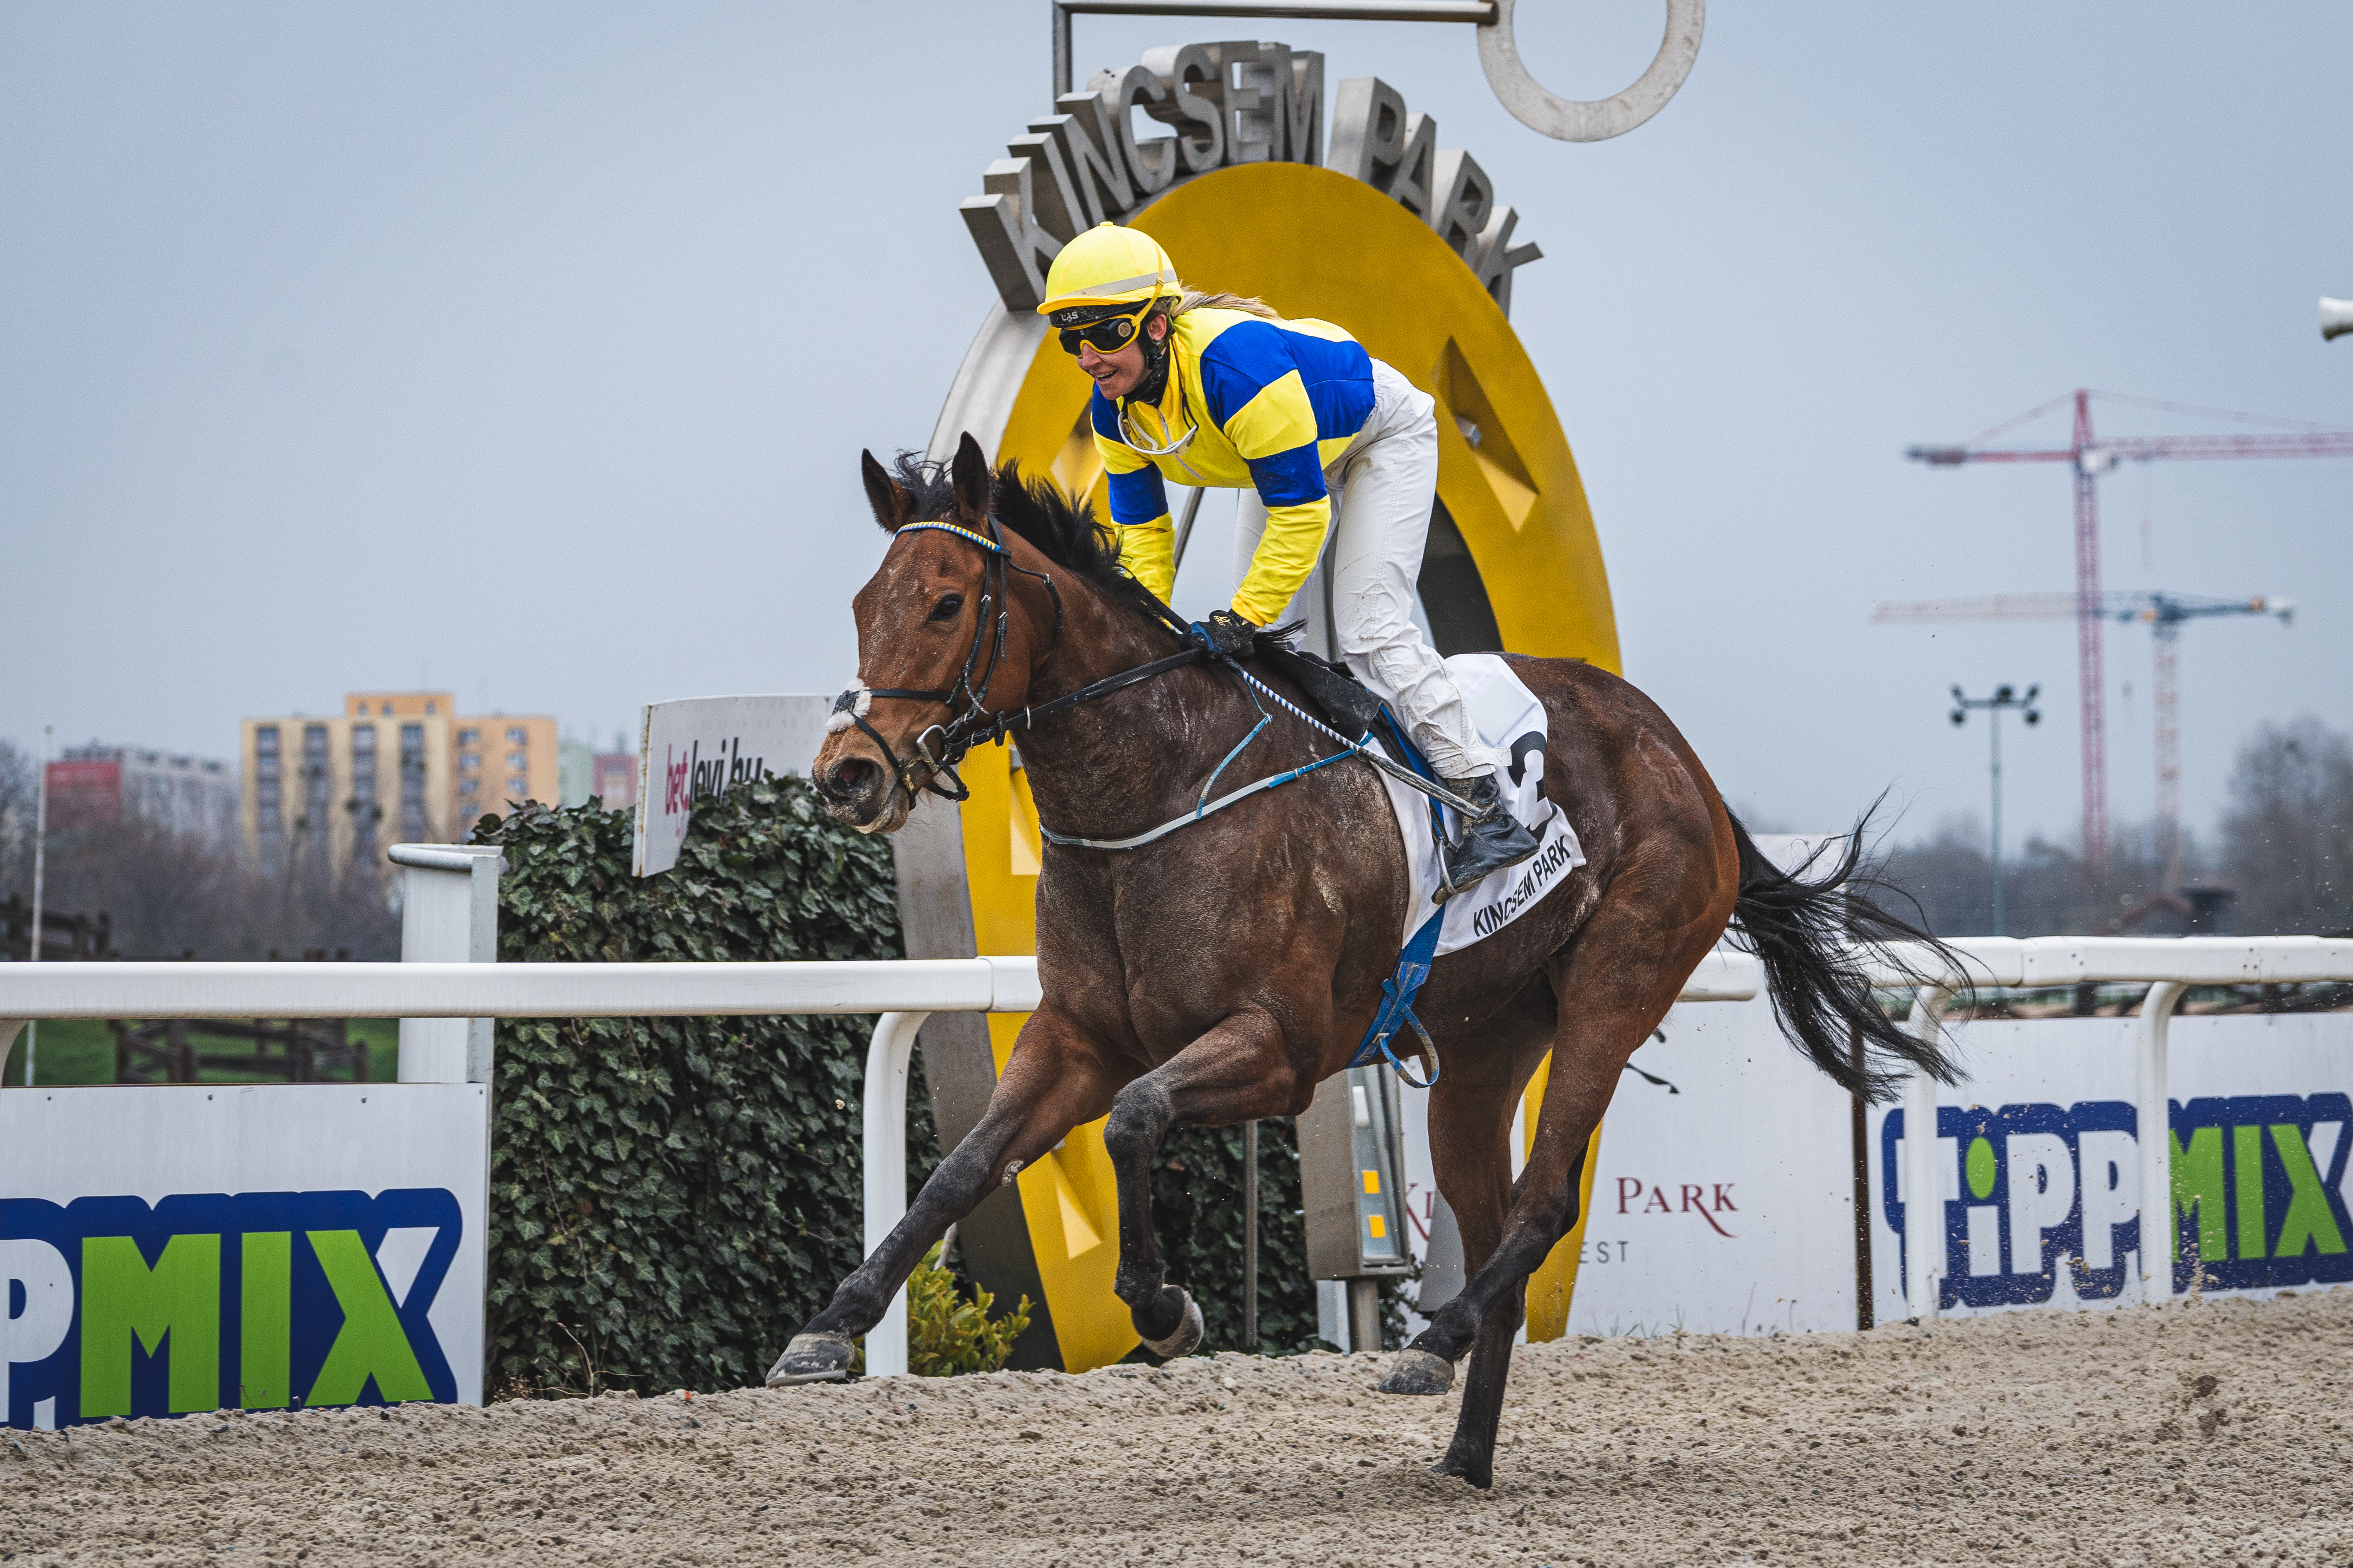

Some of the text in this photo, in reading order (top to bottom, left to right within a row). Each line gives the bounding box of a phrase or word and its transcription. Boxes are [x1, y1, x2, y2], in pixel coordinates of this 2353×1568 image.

[959, 39, 1545, 320] KINCSEM PARK
[1473, 835, 1571, 937] KINCSEM PARK
